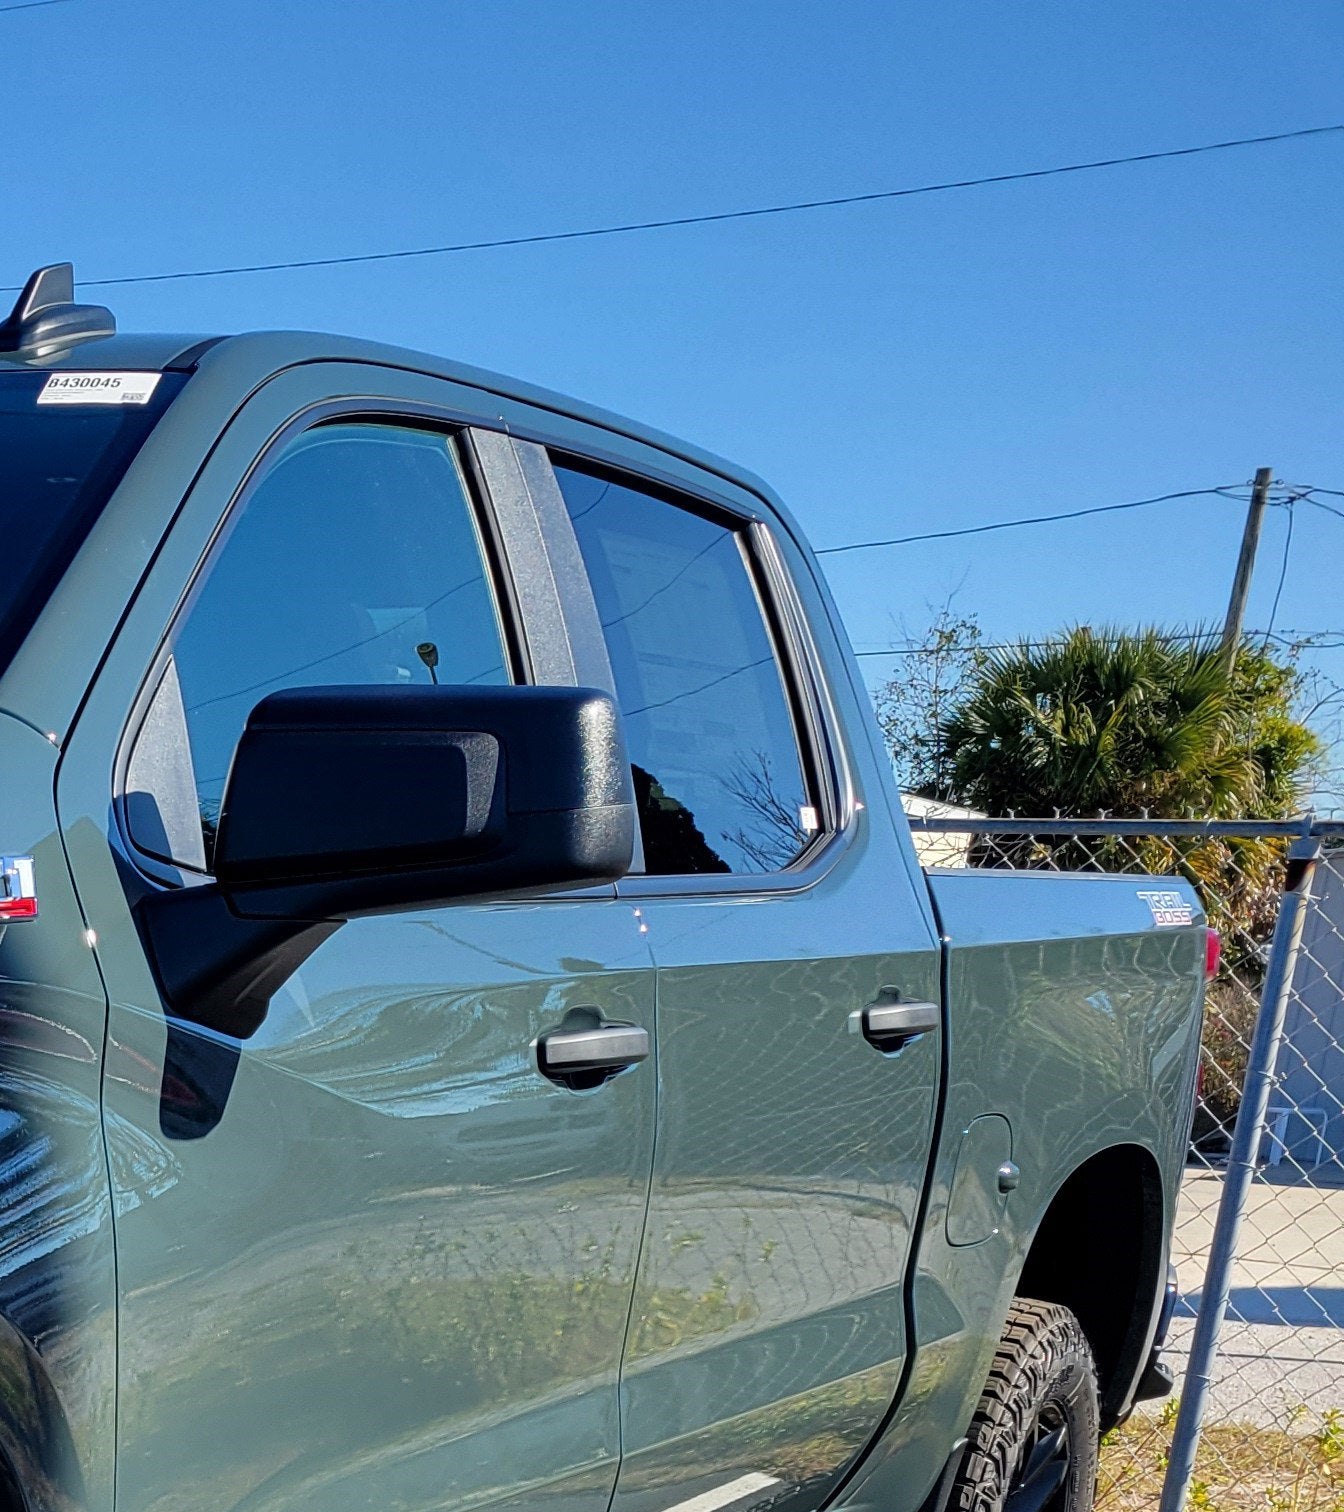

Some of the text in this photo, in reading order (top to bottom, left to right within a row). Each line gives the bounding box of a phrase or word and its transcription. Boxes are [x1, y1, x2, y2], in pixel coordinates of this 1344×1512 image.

[48, 377, 122, 388] B430045
[1136, 891, 1191, 909] TRAIL
[1153, 910, 1192, 926] BOSS
